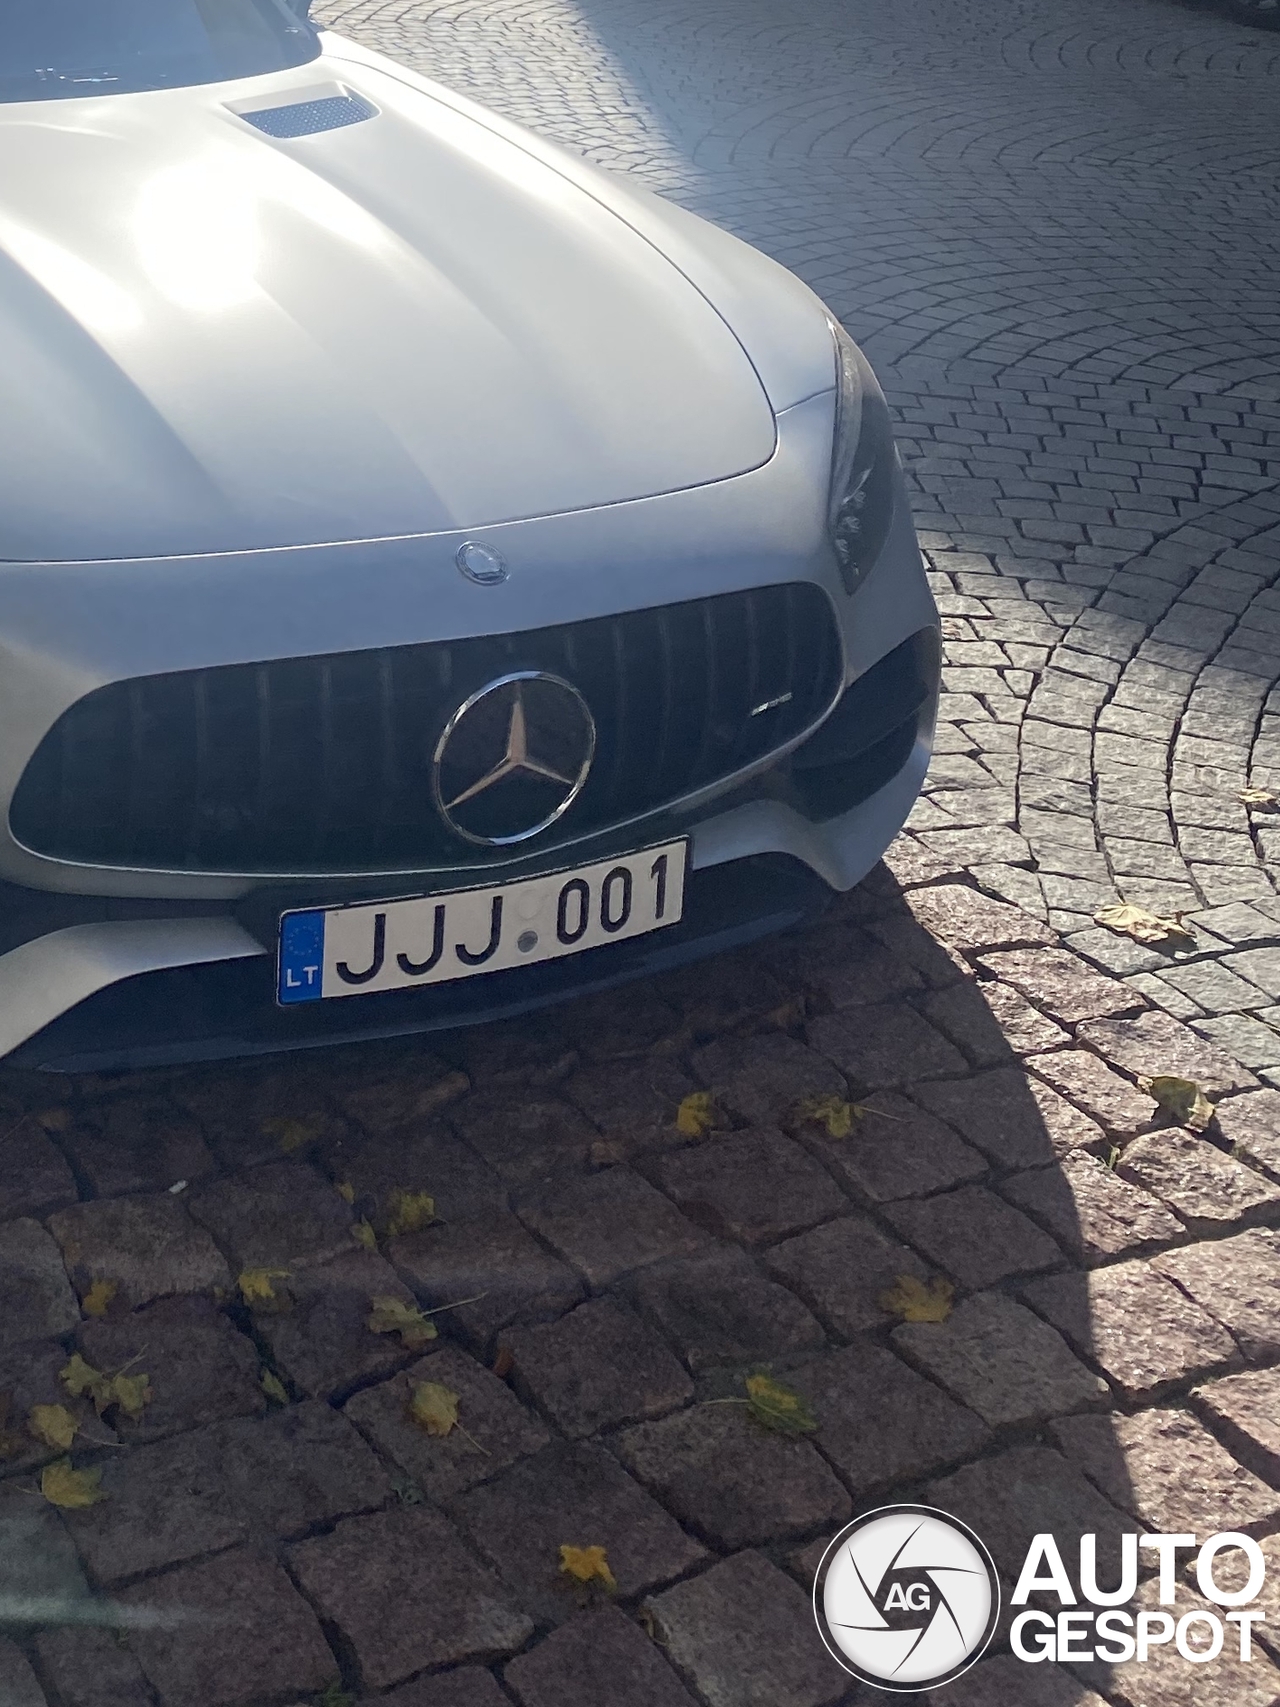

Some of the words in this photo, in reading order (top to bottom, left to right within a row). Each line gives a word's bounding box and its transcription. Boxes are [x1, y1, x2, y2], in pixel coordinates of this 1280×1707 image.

[335, 895, 504, 986] JJJ
[556, 853, 669, 947] 001
[286, 965, 319, 988] LT
